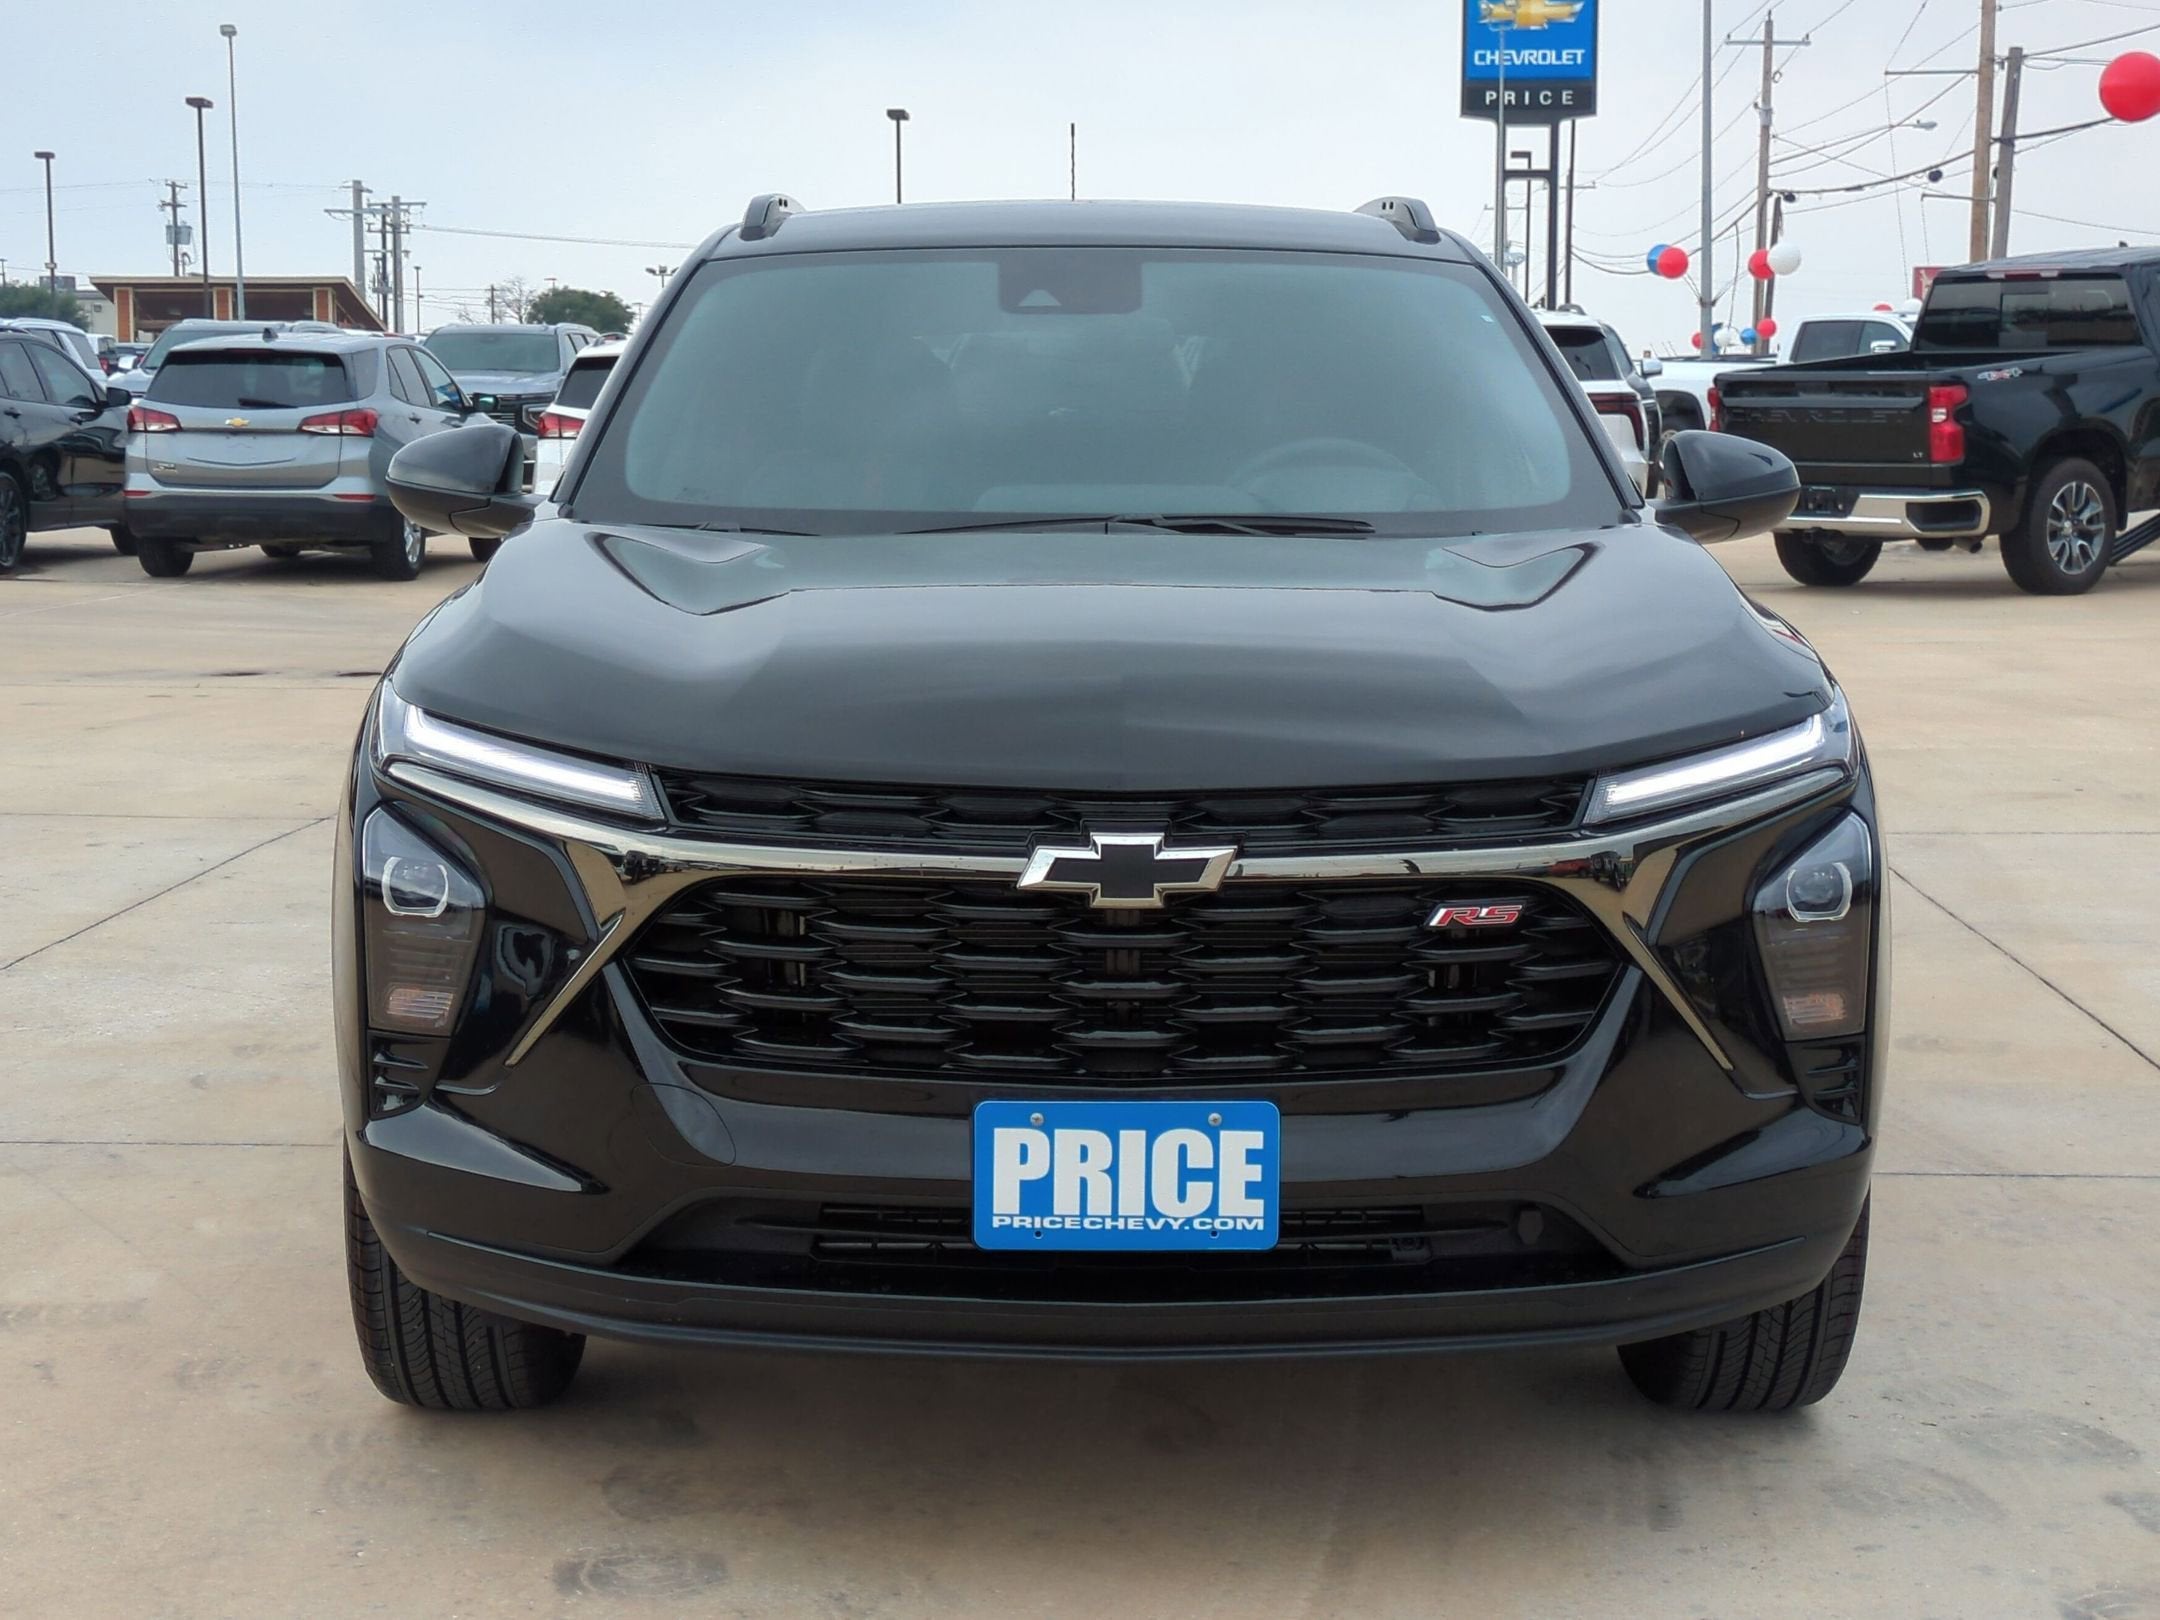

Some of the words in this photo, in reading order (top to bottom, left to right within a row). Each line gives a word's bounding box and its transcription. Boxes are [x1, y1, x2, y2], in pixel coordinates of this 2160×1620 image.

[1474, 49, 1586, 66] CHEVROLET
[1485, 90, 1575, 106] PRICE
[1429, 905, 1522, 926] RS
[992, 1127, 1265, 1218] PRICE
[992, 1216, 1265, 1231] PRICECHEVY.COM
